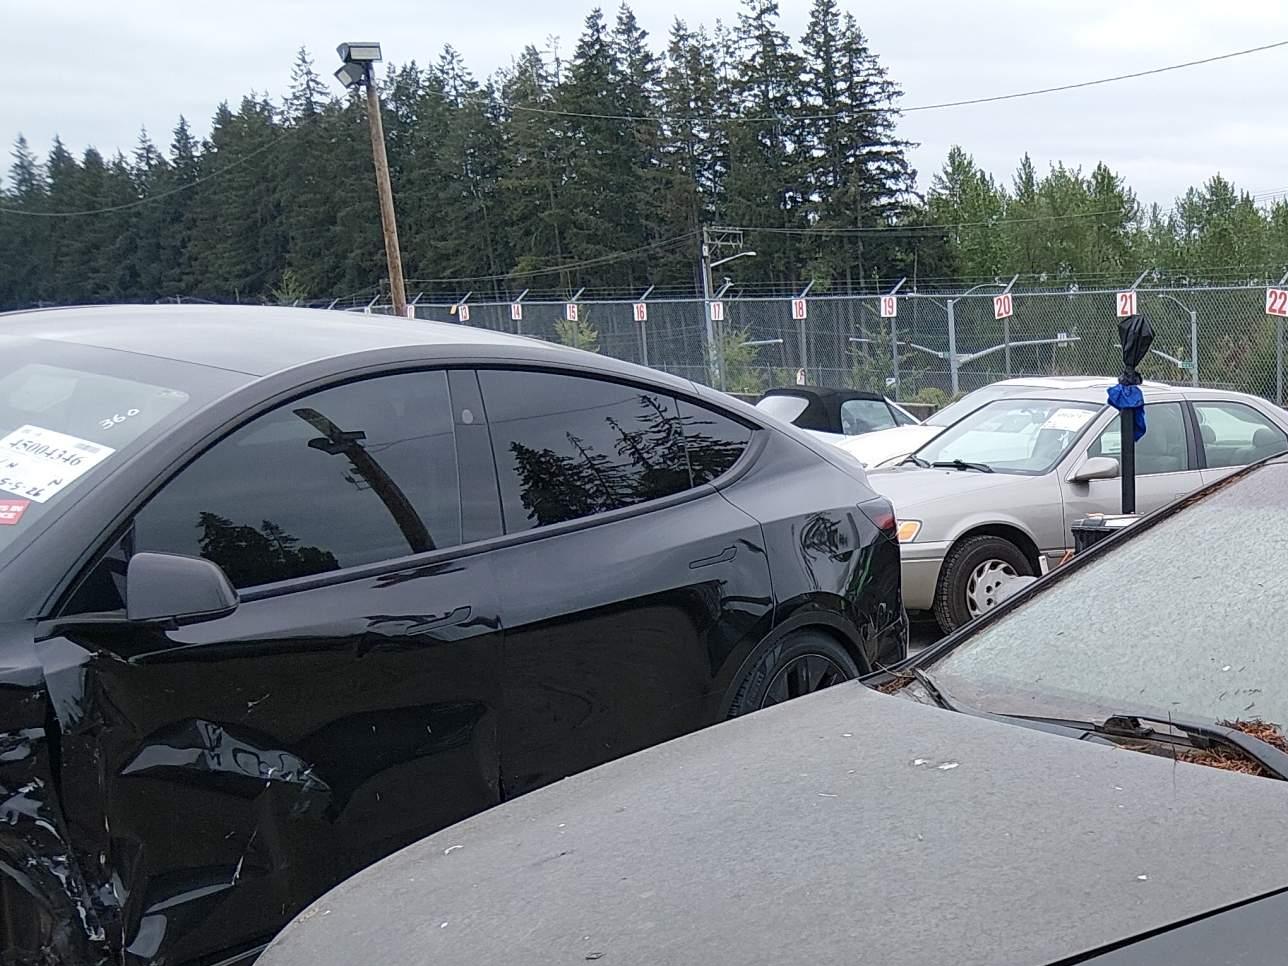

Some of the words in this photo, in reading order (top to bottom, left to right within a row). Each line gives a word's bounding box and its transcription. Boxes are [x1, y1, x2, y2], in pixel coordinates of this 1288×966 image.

[712, 302, 721, 319] 17
[794, 300, 804, 318] 18
[883, 297, 894, 316] 19
[996, 295, 1011, 316] 20
[1120, 294, 1133, 316] 21
[1268, 290, 1288, 315] 22
[460, 305, 469, 320] 13
[513, 304, 521, 319] 14
[568, 305, 576, 320] 15
[636, 303, 645, 320] 16
